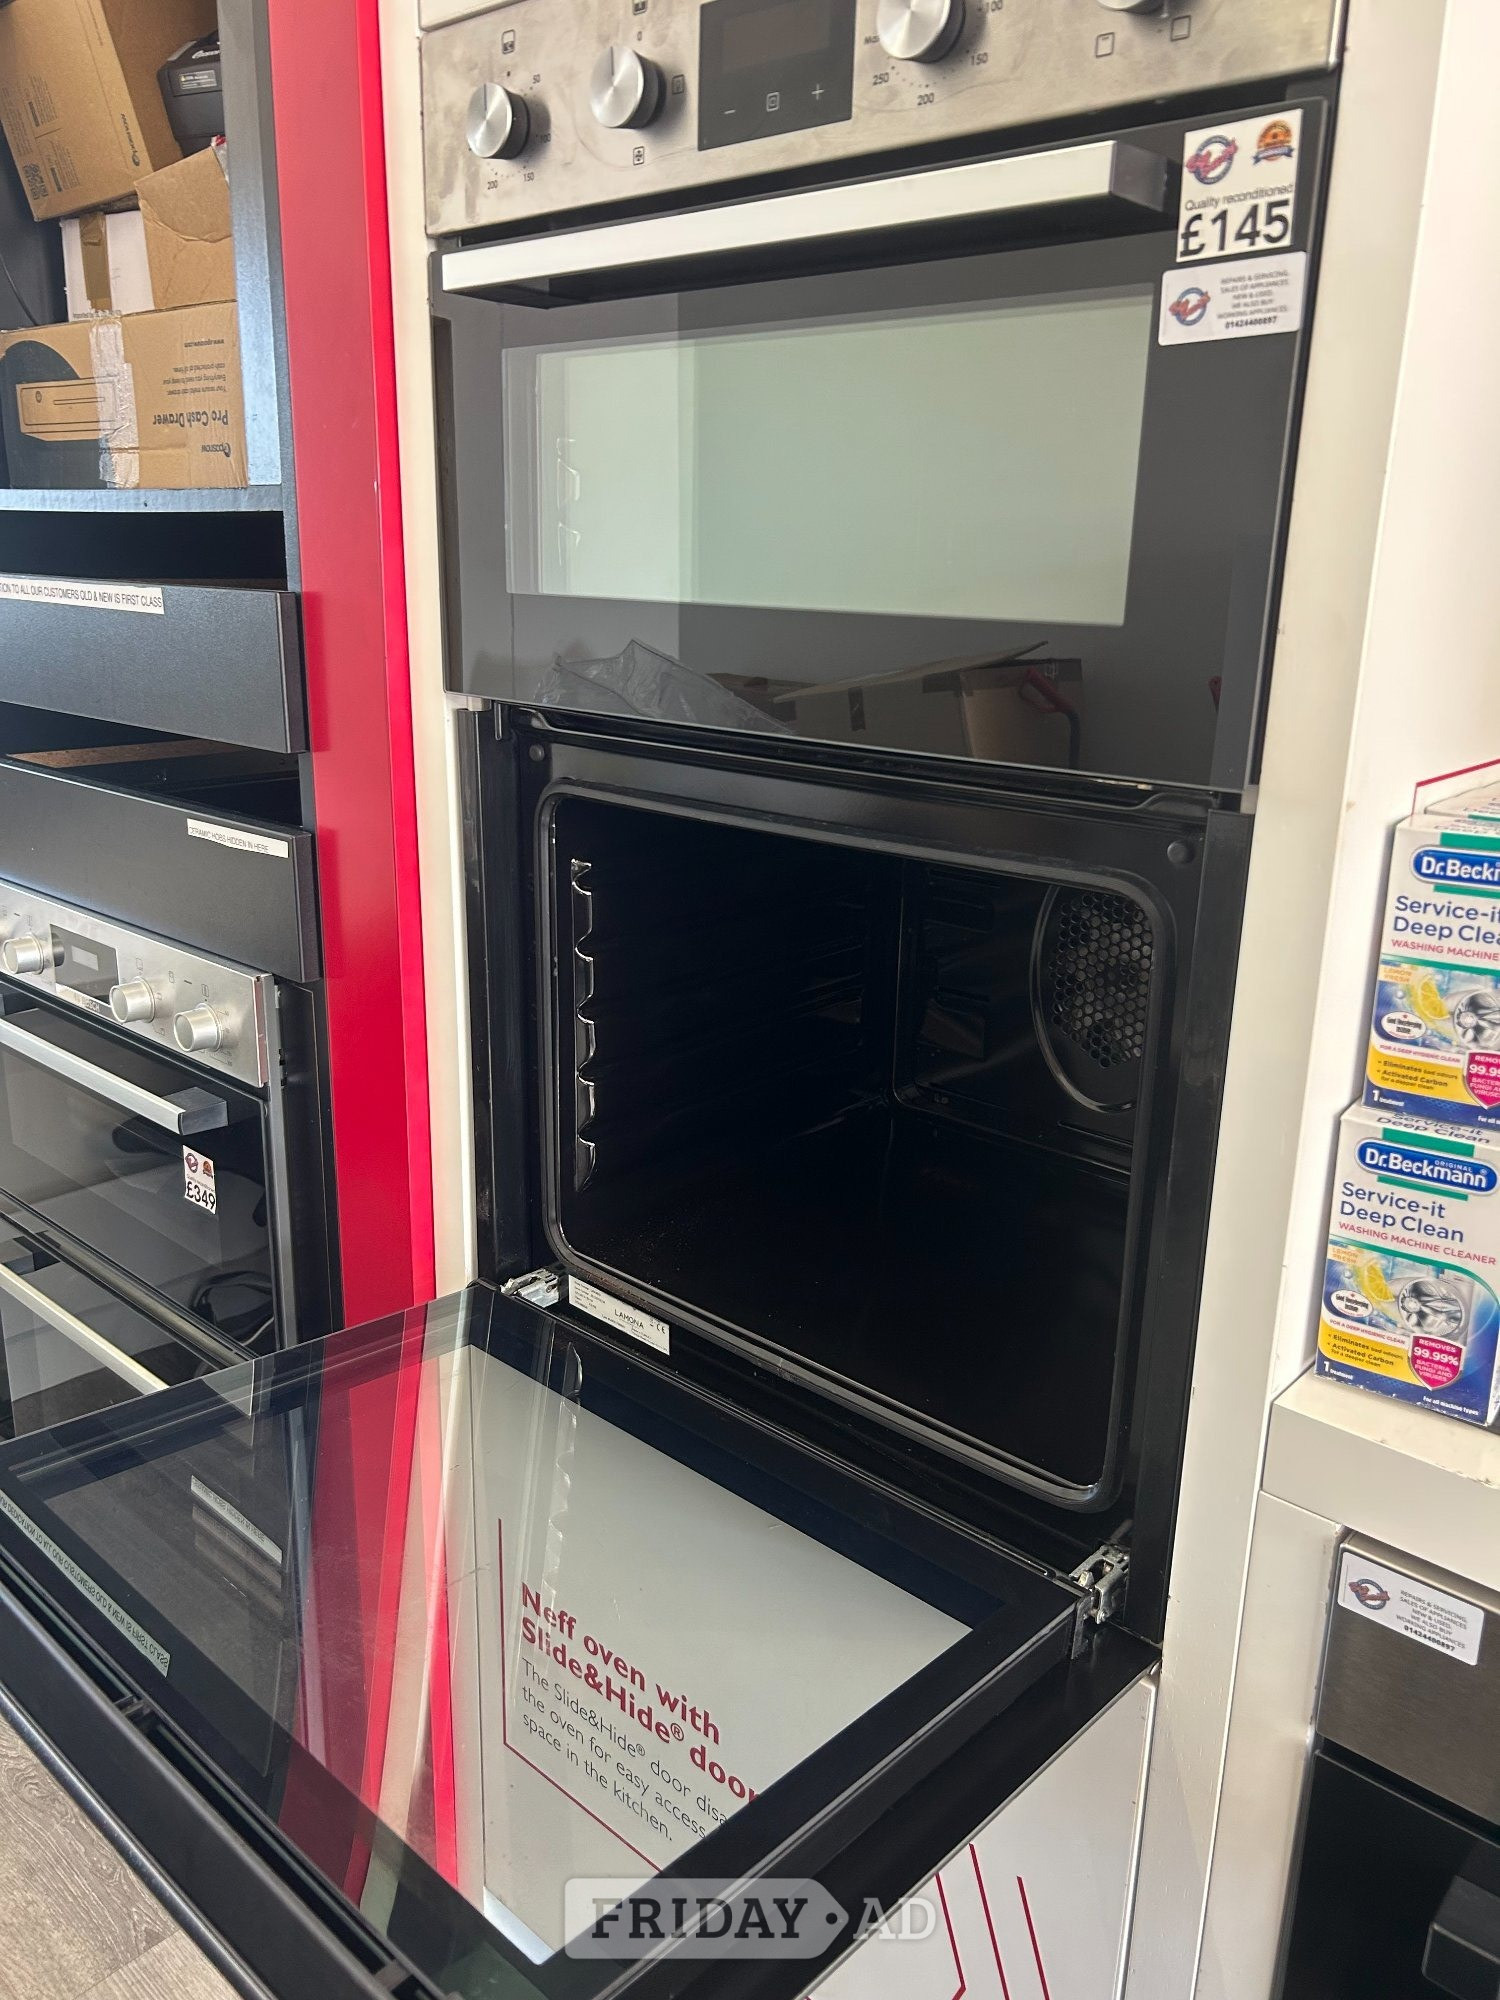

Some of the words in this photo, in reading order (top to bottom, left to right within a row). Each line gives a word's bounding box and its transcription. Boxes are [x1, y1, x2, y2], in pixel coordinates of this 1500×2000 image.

[971, 52, 989, 66] 150
[533, 74, 541, 84] 50
[873, 72, 889, 86] 250
[917, 92, 934, 106] 200
[487, 180, 498, 190] 200
[524, 172, 535, 182] 150
[1185, 197, 1219, 211] Quality
[1179, 199, 1291, 258] £145
[153, 412, 185, 428] Drawer
[187, 410, 209, 428] Cash
[212, 410, 229, 426] Pro
[11, 583, 19, 594] TO
[20, 584, 30, 595] ALL
[31, 585, 44, 597] OUR
[44, 587, 79, 601] CUSTOMERS
[81, 590, 93, 601] OLD
[99, 592, 113, 604] NEW
[114, 593, 121, 604] IS
[122, 594, 140, 606] FIRST
[141, 595, 163, 608] CLASS
[1393, 916, 1453, 941] Deep
[1391, 939, 1444, 954] WASHING
[1447, 946, 1500, 961] MACHINE
[1383, 1060, 1422, 1073] Eliminates
[1381, 1069, 1418, 1081] Activated
[1420, 1076, 1448, 1087] Carbon
[1372, 1090, 1379, 1102] 1
[1377, 1117, 1427, 1131] Deep
[1435, 1128, 1490, 1144] Clean
[1393, 1111, 1483, 1136] Service-it
[1434, 1159, 1473, 1173] ORIGINAL
[186, 1181, 215, 1210] £349
[1341, 1181, 1446, 1219] Service-it
[1340, 1200, 1397, 1228] Deep
[1401, 1215, 1464, 1243] Clean
[1338, 1221, 1388, 1240] WASHING
[1391, 1234, 1441, 1253] MACHINE
[1443, 1247, 1497, 1265] CLEANER
[614, 1308, 644, 1329] LAMONA
[1333, 1334, 1370, 1350] Eliminates
[1386, 1336, 1406, 1345] CLEAN
[1418, 1338, 1456, 1353] REMOVES
[1332, 1342, 1366, 1358] Activated
[1367, 1353, 1394, 1366] Carbon
[1413, 1346, 1459, 1366] 99.99%
[1323, 1361, 1330, 1372] 1
[1423, 1395, 1431, 1403] For
[1400, 1596, 1418, 1608] SALES
[1429, 1608, 1467, 1630] APPLIANCES
[1422, 1619, 1438, 1630] ALSO
[1439, 1627, 1453, 1635] BUY
[522, 1582, 577, 1640] Neff
[583, 1634, 645, 1692] oven
[655, 1683, 720, 1745] with
[522, 1657, 549, 1692] The
[651, 1759, 691, 1798] door
[522, 1686, 545, 1714] the
[550, 1710, 584, 1744] oven
[589, 1736, 612, 1763] for
[616, 1761, 650, 1796] easy
[655, 1791, 706, 1839] access
[523, 1713, 561, 1752] space
[567, 1744, 579, 1766] in
[584, 1760, 608, 1789] the
[613, 1781, 673, 1842] kitchen.
